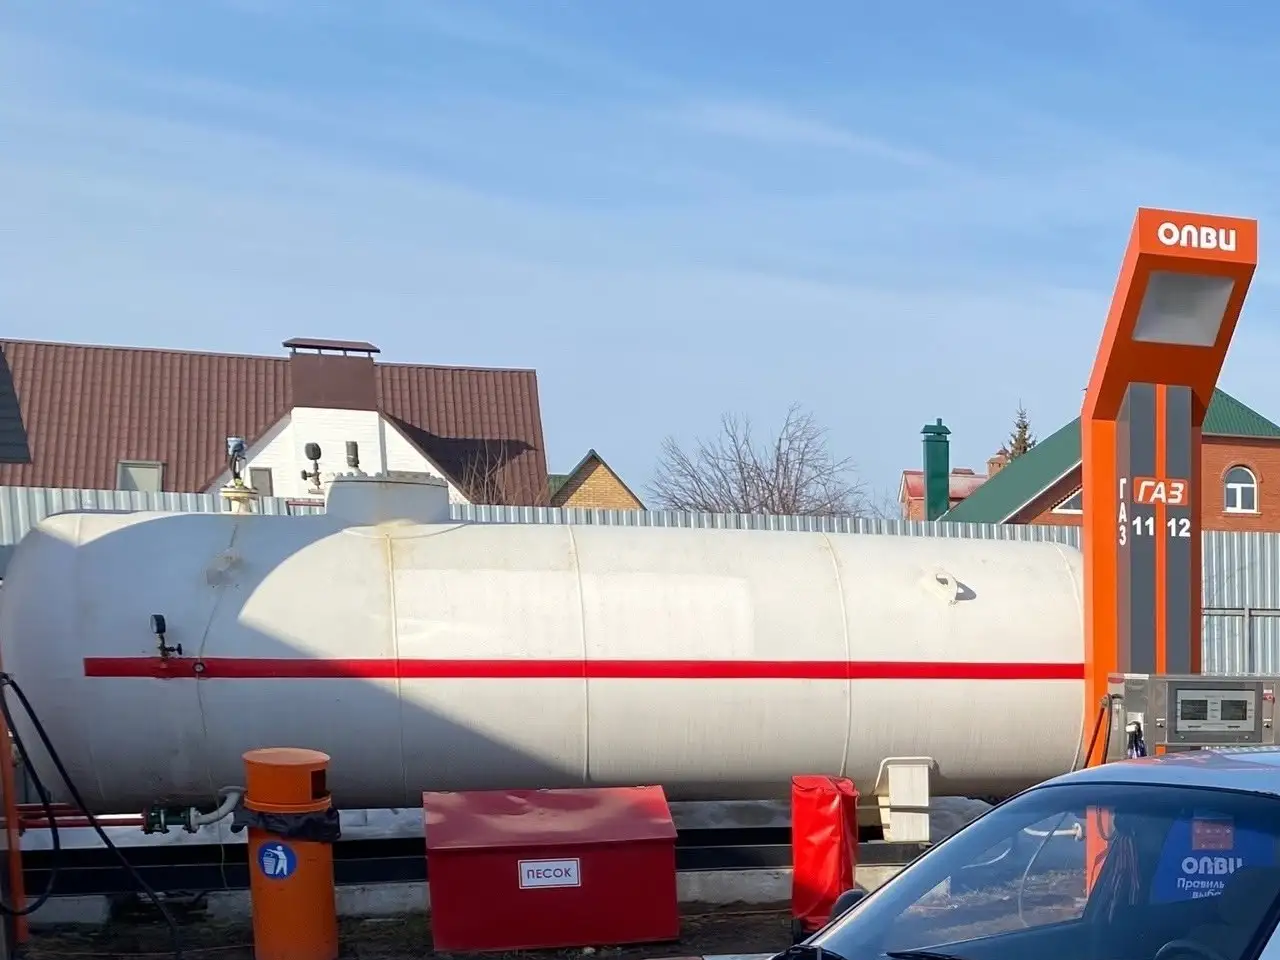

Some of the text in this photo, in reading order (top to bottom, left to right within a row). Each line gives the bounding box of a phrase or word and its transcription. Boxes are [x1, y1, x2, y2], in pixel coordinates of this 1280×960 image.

[1157, 221, 1237, 252] ОЛВИ
[1137, 480, 1185, 504] ГАЗ
[1118, 477, 1128, 546] ГАЗ
[1132, 516, 1191, 537] 11 12
[526, 867, 572, 880] ПЕСОК
